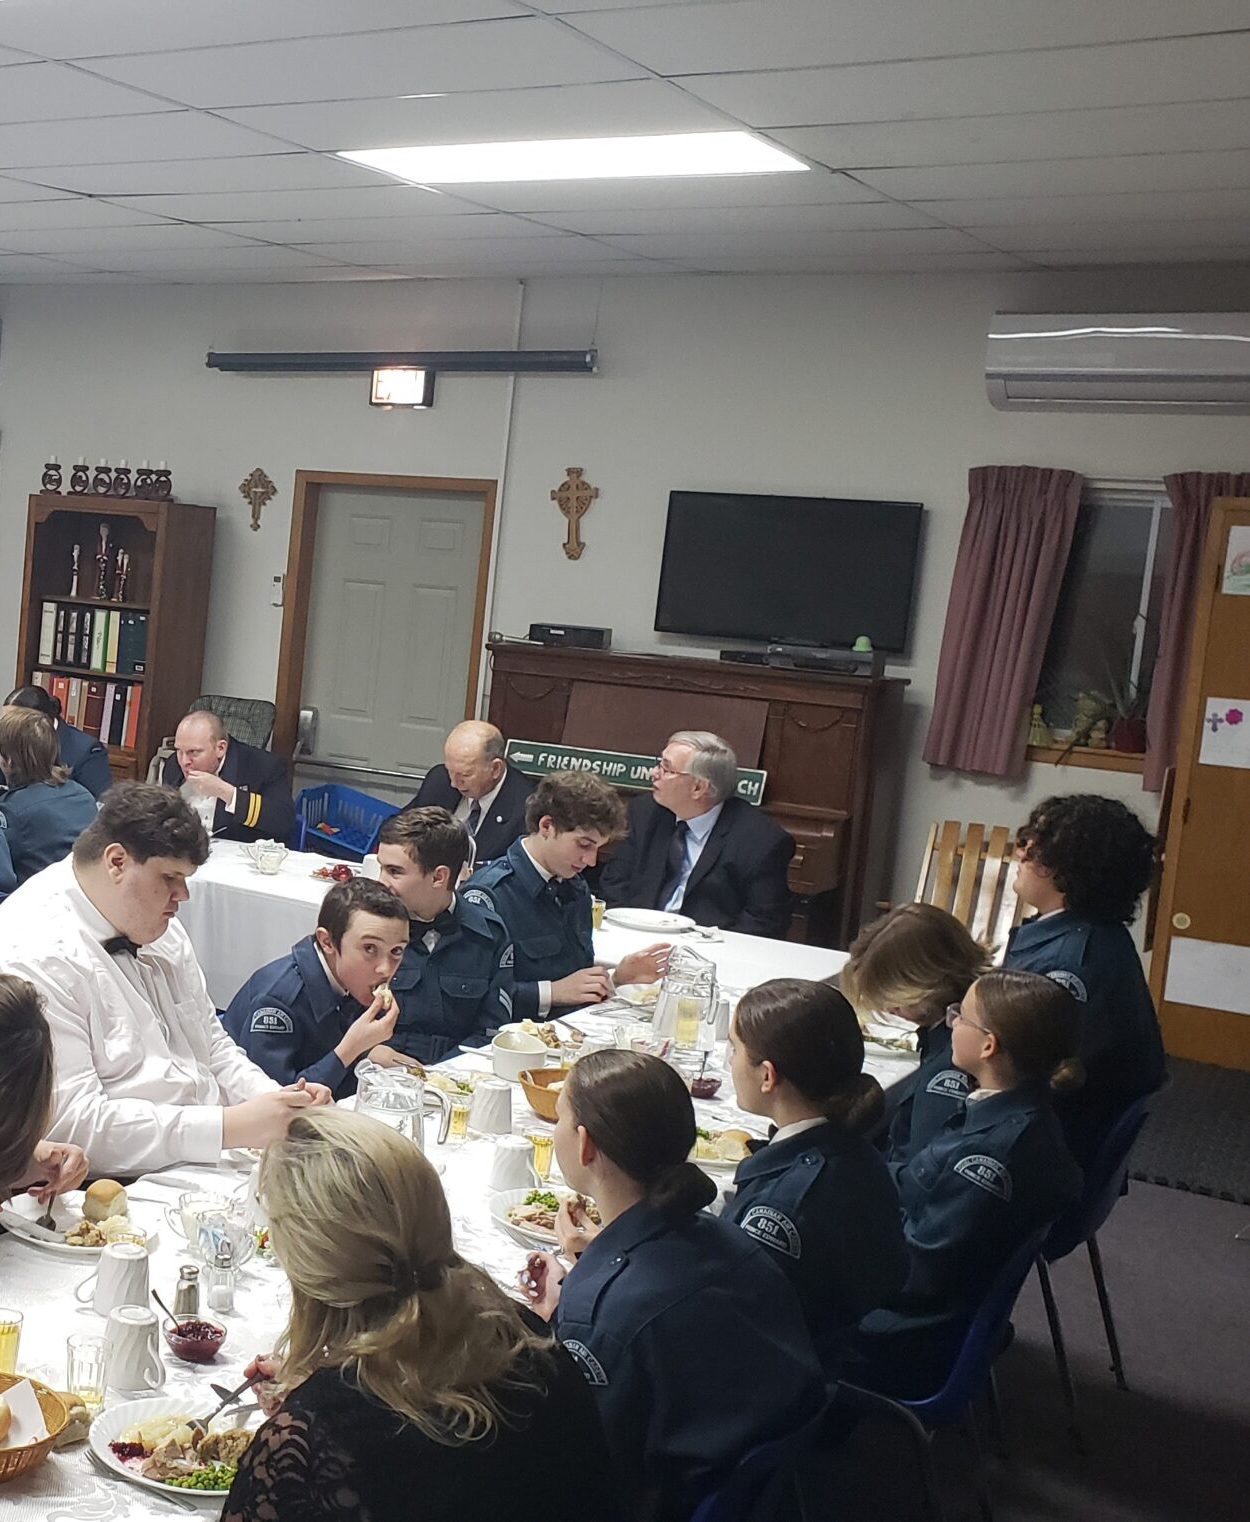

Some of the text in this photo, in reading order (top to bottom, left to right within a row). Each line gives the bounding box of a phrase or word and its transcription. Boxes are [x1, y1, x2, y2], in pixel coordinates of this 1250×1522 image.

[538, 752, 760, 796] FRIENDSHIP UN CH
[977, 1165, 997, 1182] 851
[757, 1217, 780, 1237] 851
